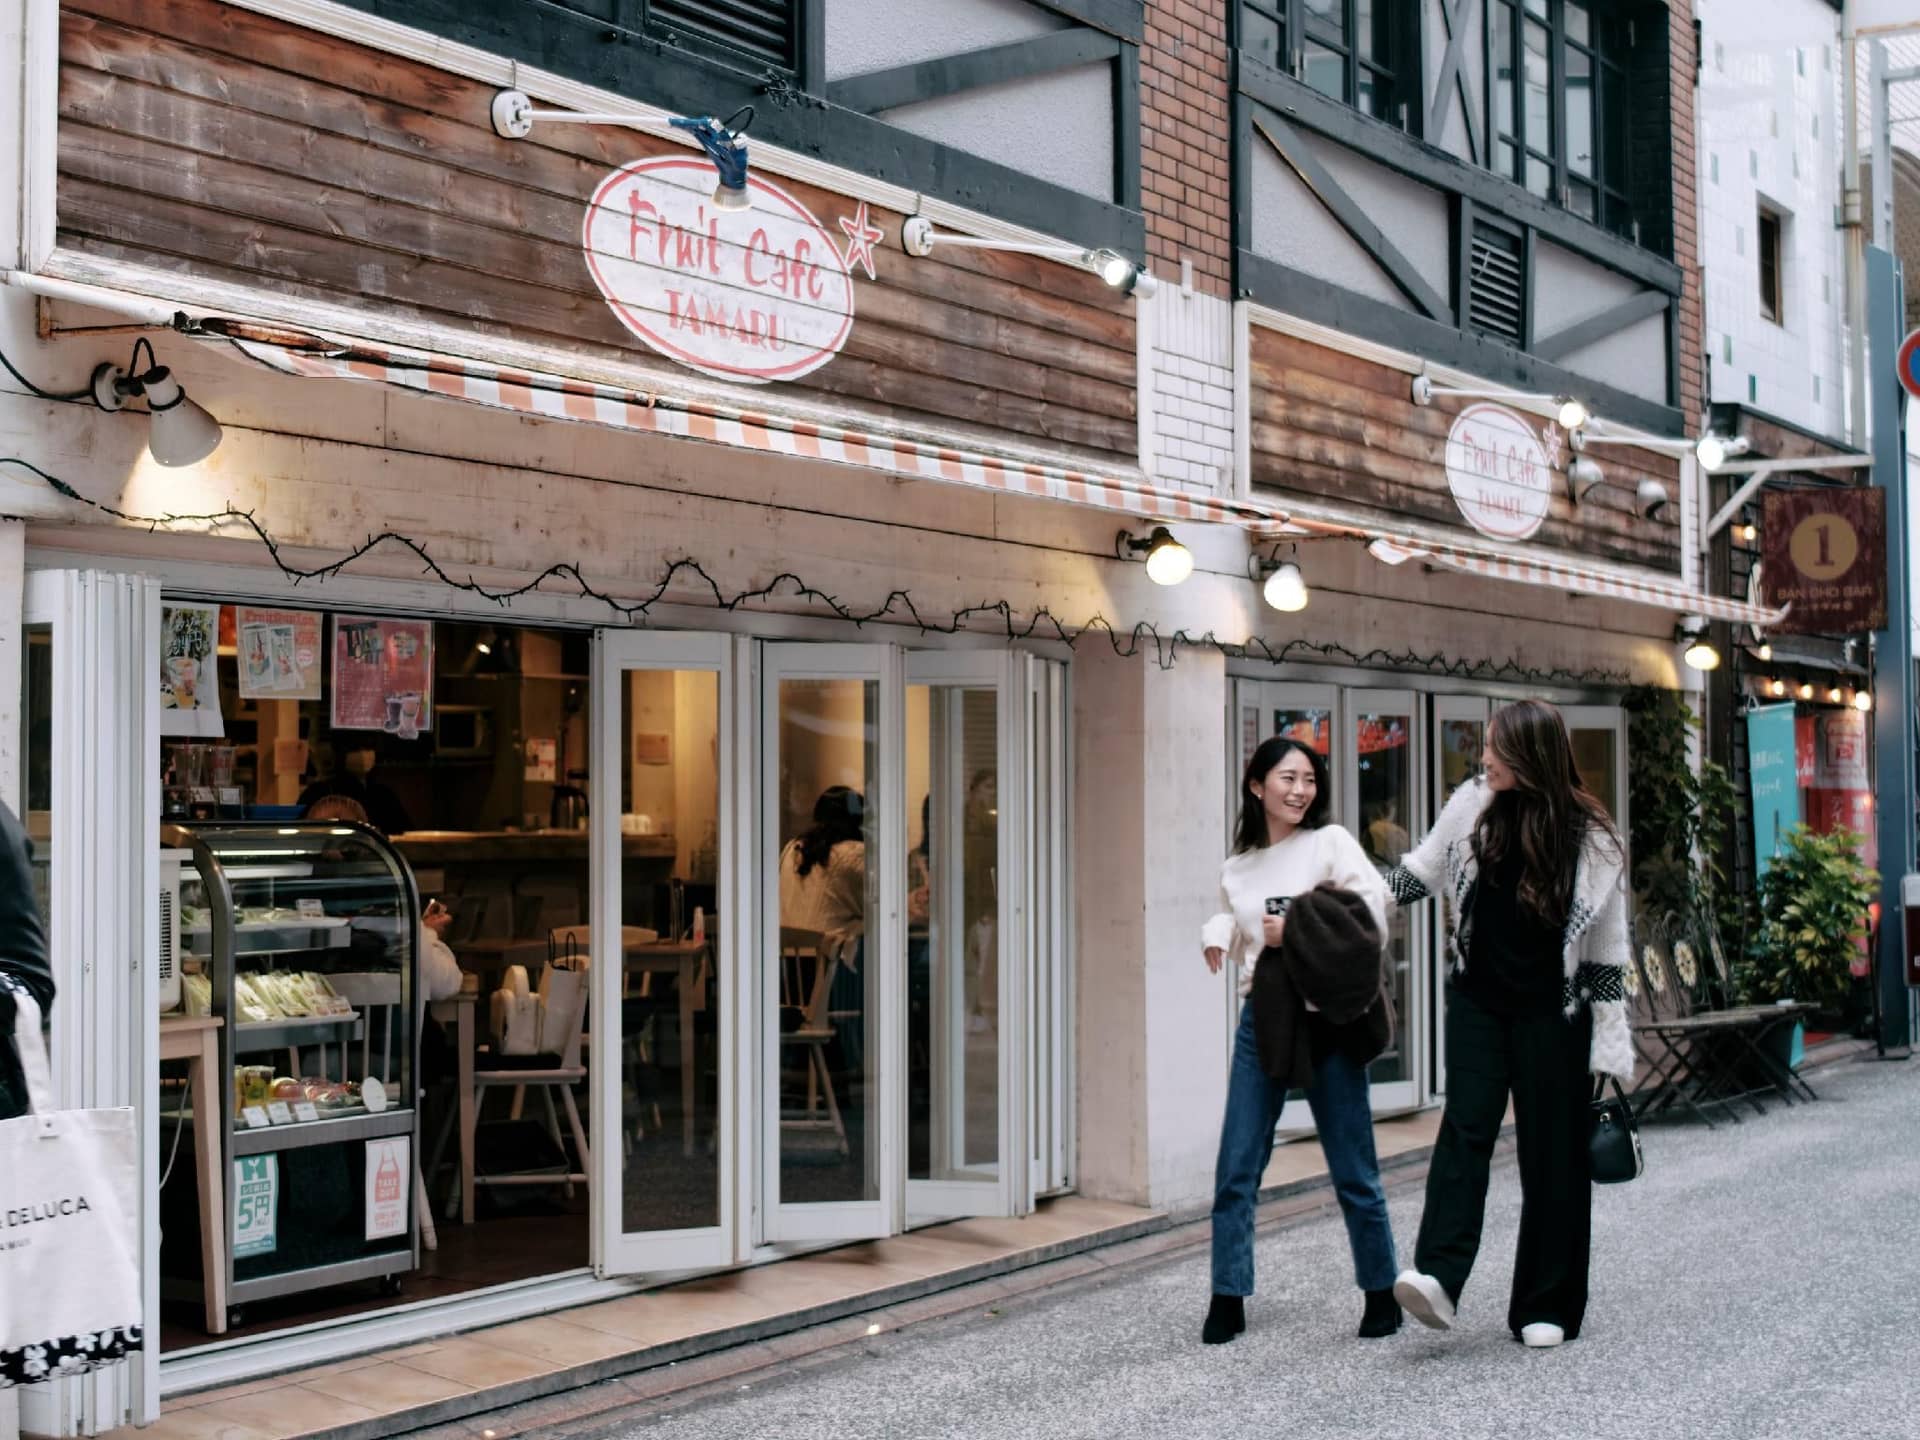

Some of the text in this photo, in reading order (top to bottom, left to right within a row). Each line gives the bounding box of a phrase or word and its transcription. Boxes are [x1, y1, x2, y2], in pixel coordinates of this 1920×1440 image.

[628, 189, 824, 300] Fruit Cafe
[663, 289, 787, 351] TAMARU
[1813, 524, 1835, 567] 1
[7, 1196, 91, 1228] DELUCA
